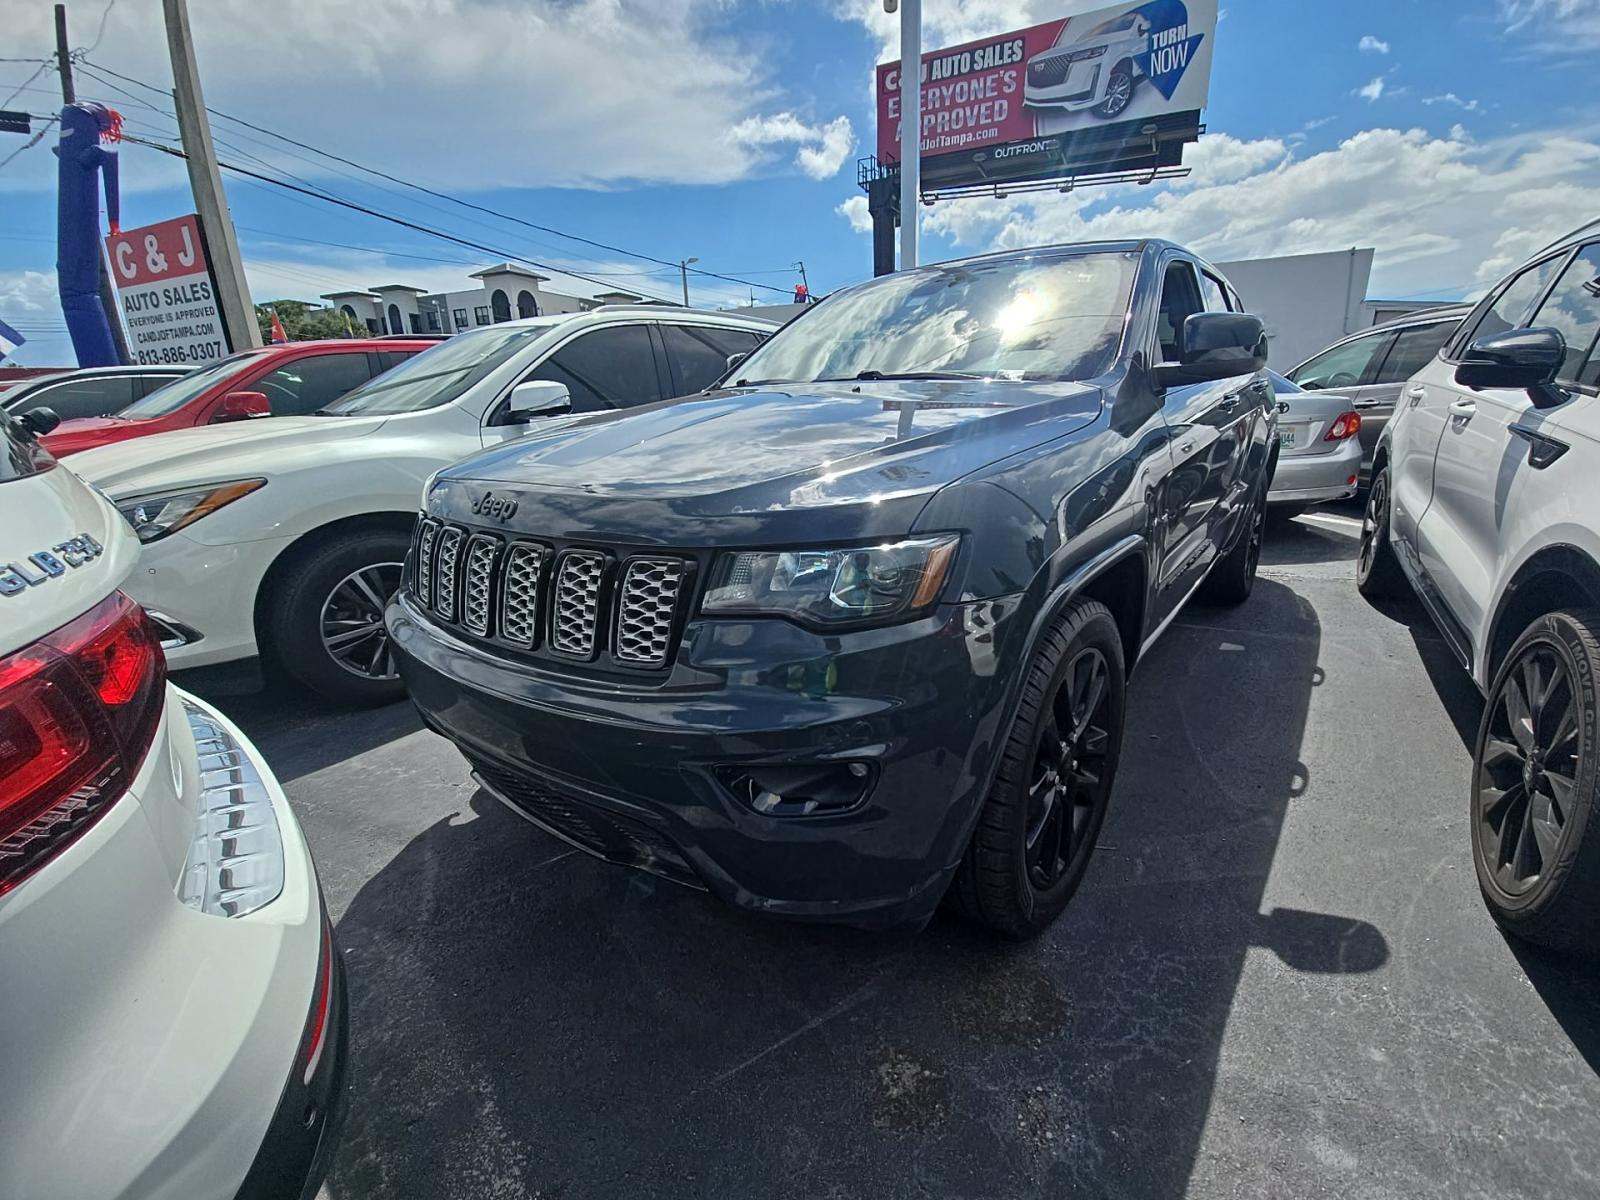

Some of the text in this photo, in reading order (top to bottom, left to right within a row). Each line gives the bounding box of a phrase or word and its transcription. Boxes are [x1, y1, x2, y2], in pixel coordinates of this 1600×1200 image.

[1152, 24, 1186, 50] TURN
[885, 70, 898, 91] C
[931, 52, 971, 81] AUTO
[973, 40, 1023, 71] SALES
[1151, 41, 1188, 77] NOW
[888, 70, 1017, 119] EERYONE'S
[116, 225, 195, 279] C & J
[125, 281, 211, 313] AUTO SALES
[128, 306, 215, 328] EVERYONE IS APPROVED
[137, 322, 215, 344] CANDJOFTAMPA.COM
[138, 340, 221, 365] 813-886-0307
[472, 491, 519, 524] Jeep
